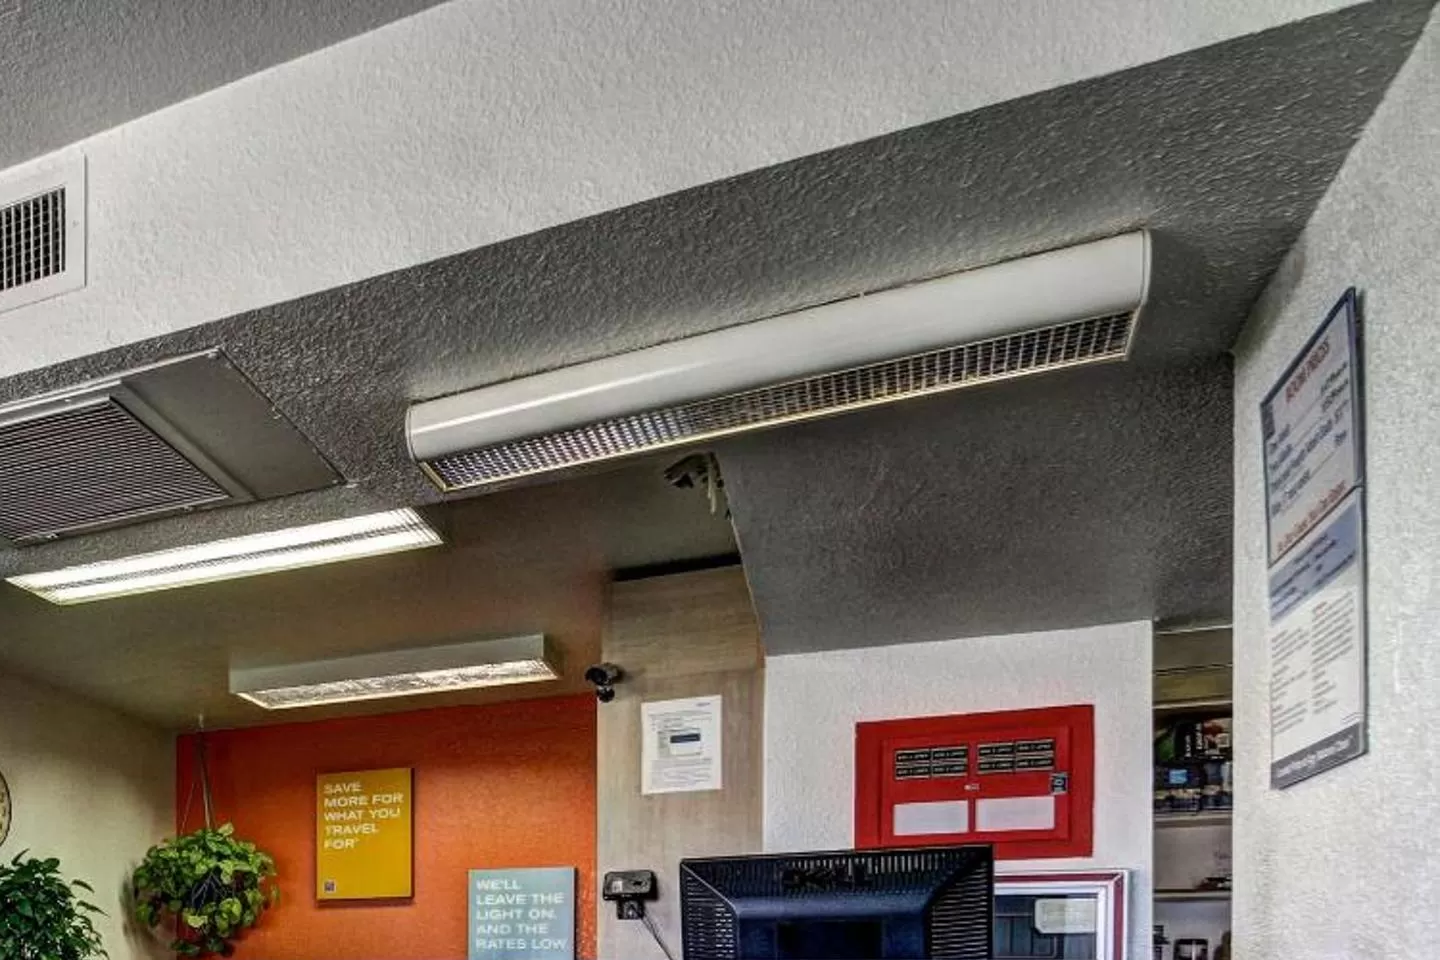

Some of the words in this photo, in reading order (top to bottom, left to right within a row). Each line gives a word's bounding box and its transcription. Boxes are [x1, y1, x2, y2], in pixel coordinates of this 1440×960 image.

[323, 781, 362, 794] SAVE
[323, 795, 368, 808] MORE
[371, 792, 404, 805] FOR
[323, 809, 364, 821] WHAT
[368, 807, 401, 819] YOU
[324, 823, 379, 837] TRAVEL
[476, 879, 521, 891] WE'LL
[476, 893, 527, 905] LEAVE
[531, 892, 565, 905] THE
[476, 909, 522, 920] LIGHT
[476, 923, 511, 935] AND
[516, 922, 549, 935] THE
[476, 938, 527, 950] RATES
